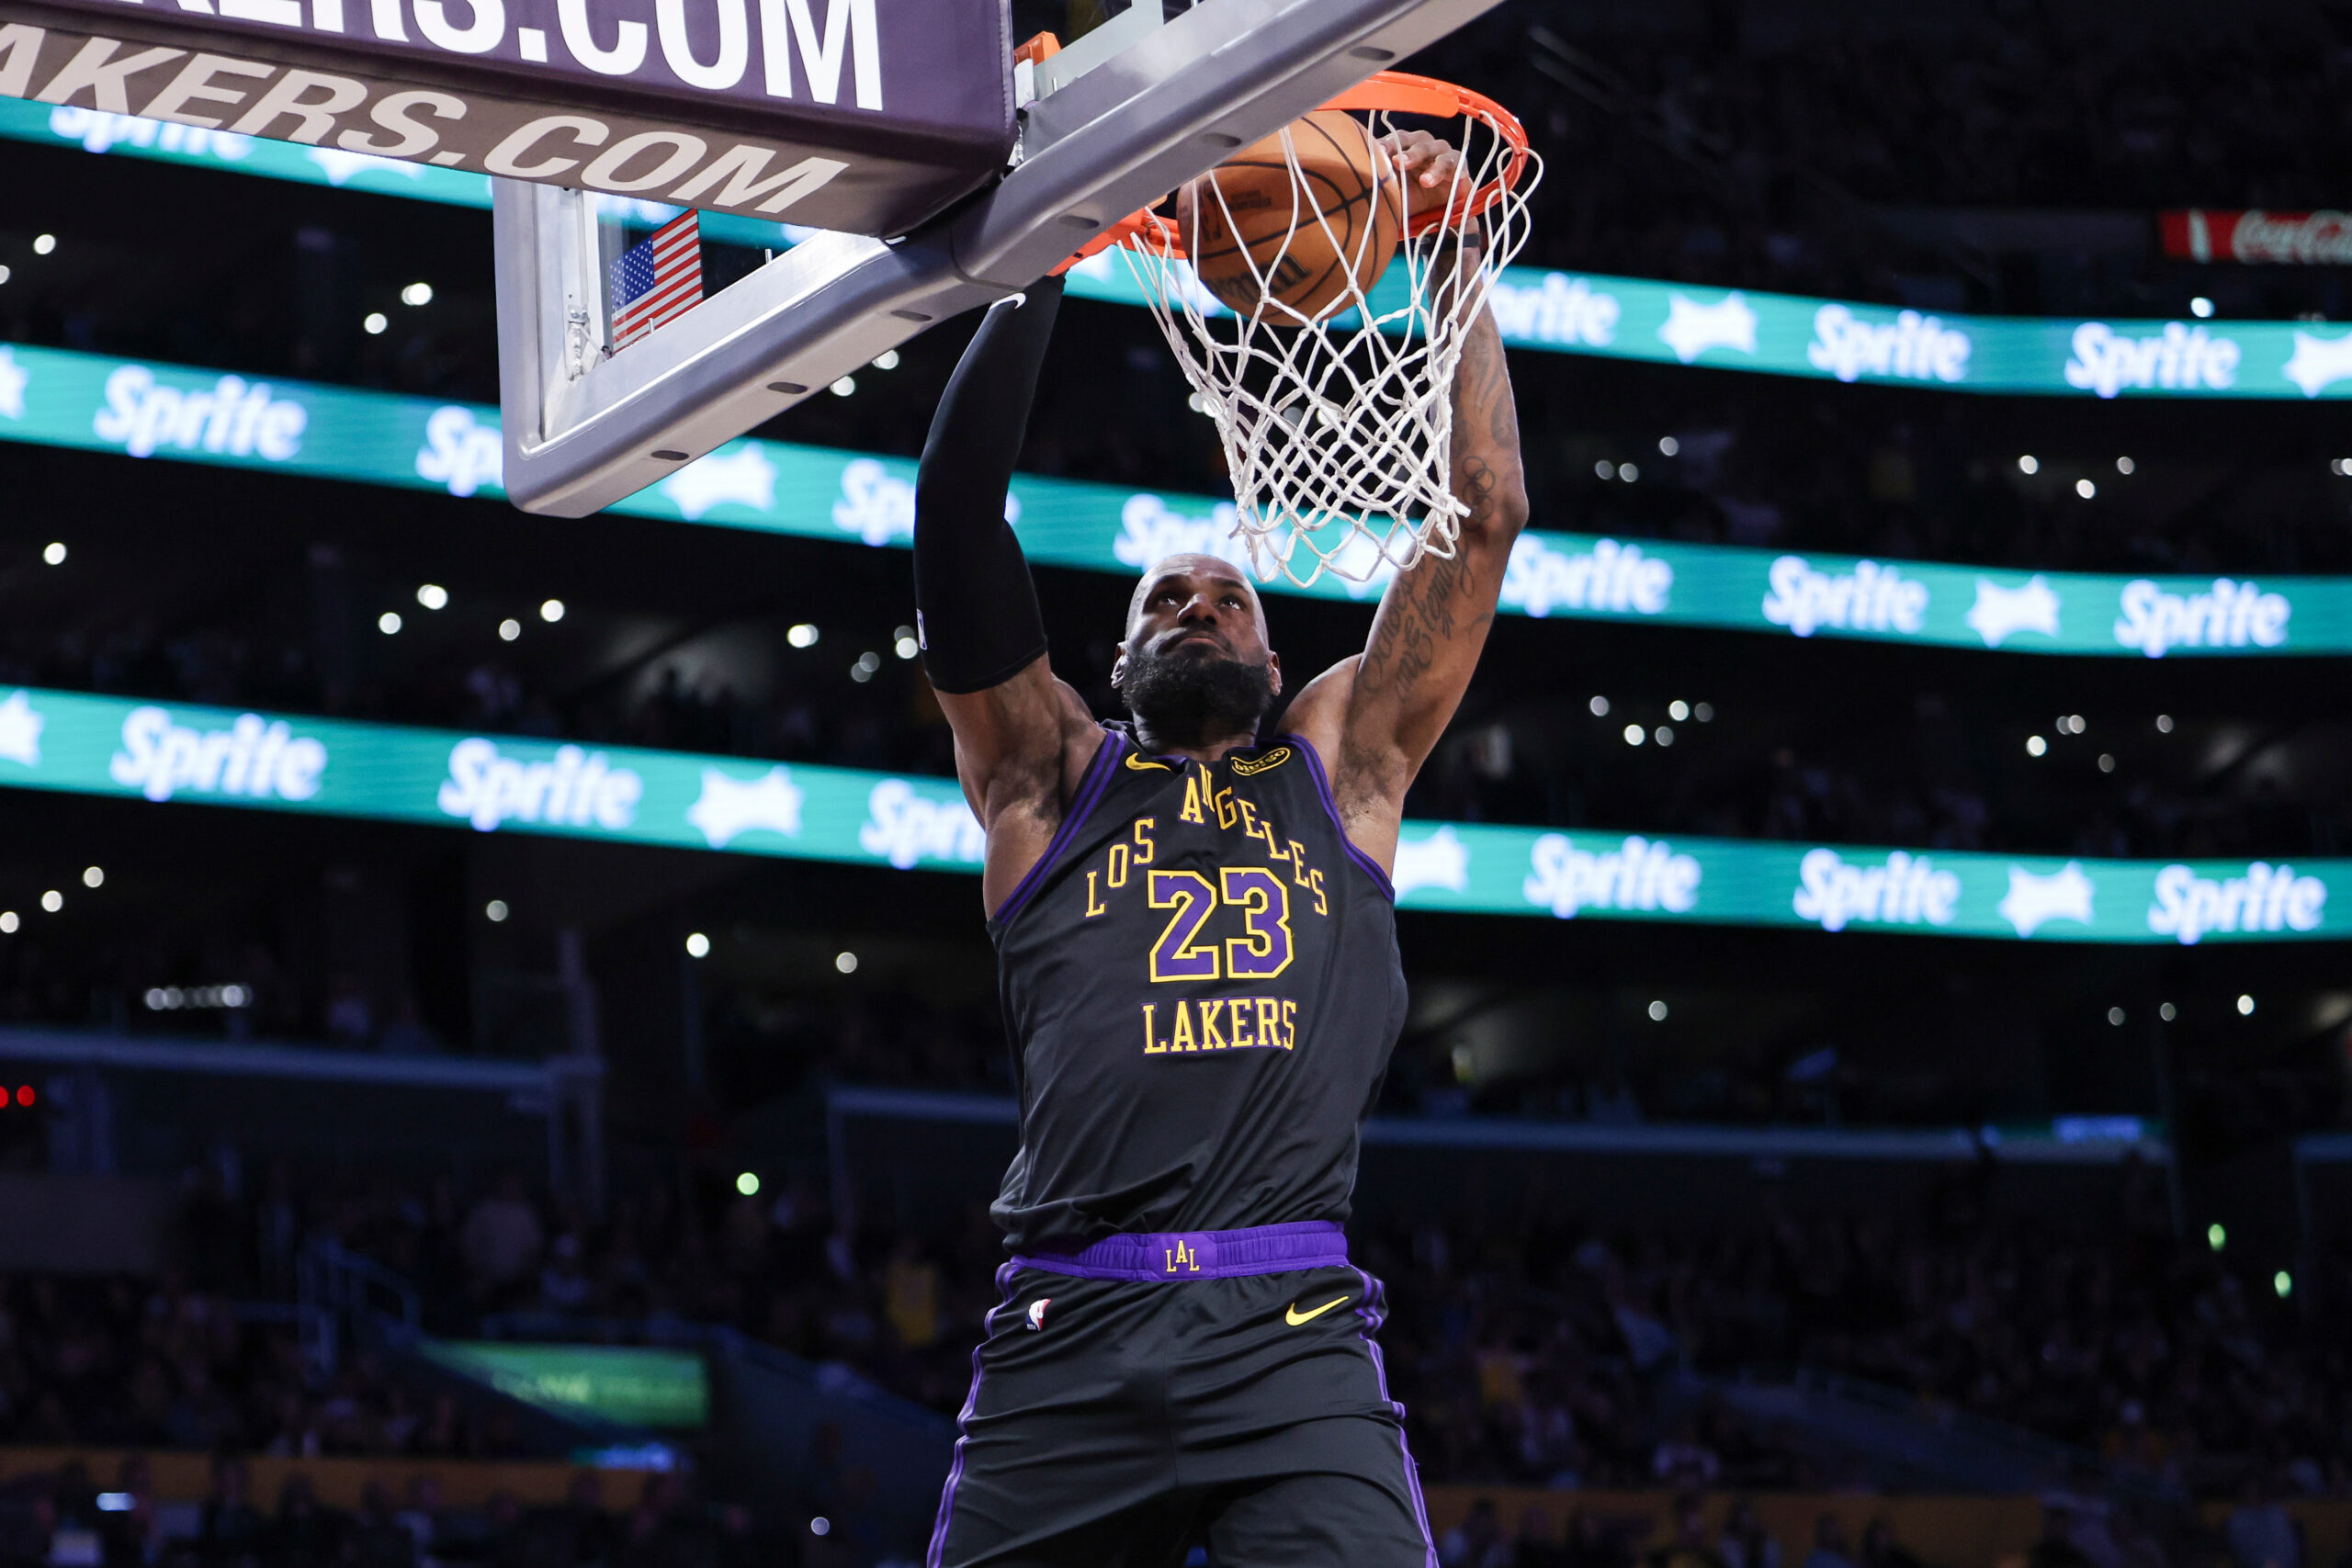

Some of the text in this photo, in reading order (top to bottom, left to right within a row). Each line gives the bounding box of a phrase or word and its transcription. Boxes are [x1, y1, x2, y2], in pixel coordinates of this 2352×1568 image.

[1482, 269, 2242, 398] prite Sprite Sprite
[93, 365, 307, 459] Sprite
[1499, 534, 1672, 617] Sprite
[1762, 556, 1929, 636] Sprite
[2112, 578, 2290, 657] Sprite
[108, 705, 2325, 943] Sprite Sprite Spri Sprite Sprite Sprite
[1085, 762, 1329, 918] LOS ANGELES
[1148, 866, 1295, 983] 23
[1142, 997, 1297, 1055] LAKERS
[1165, 1239, 1201, 1272] LAL
